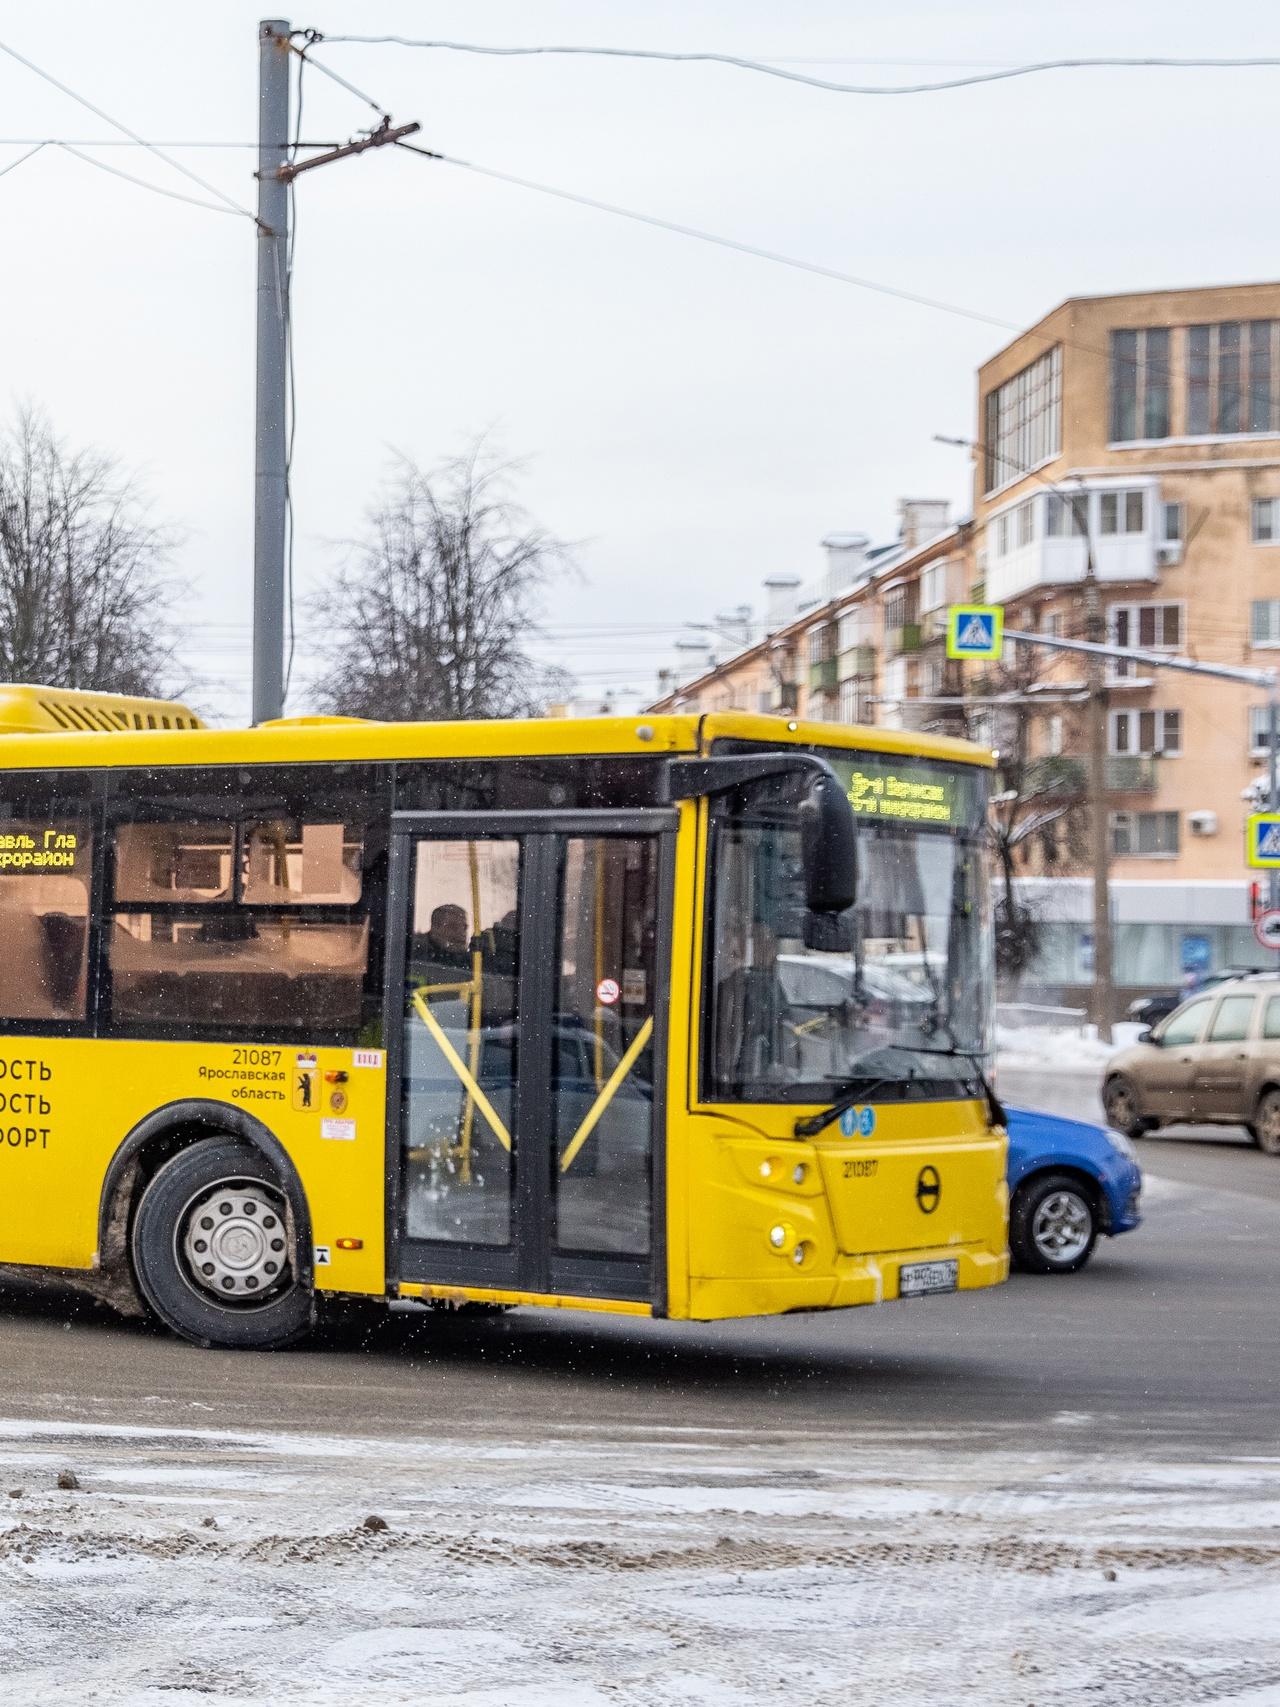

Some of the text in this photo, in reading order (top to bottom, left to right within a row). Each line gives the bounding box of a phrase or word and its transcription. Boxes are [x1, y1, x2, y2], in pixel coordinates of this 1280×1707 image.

[44, 831, 77, 849] Гла
[232, 1049, 282, 1066] 21087
[198, 1066, 286, 1081] Ярославская
[231, 1086, 286, 1100] область
